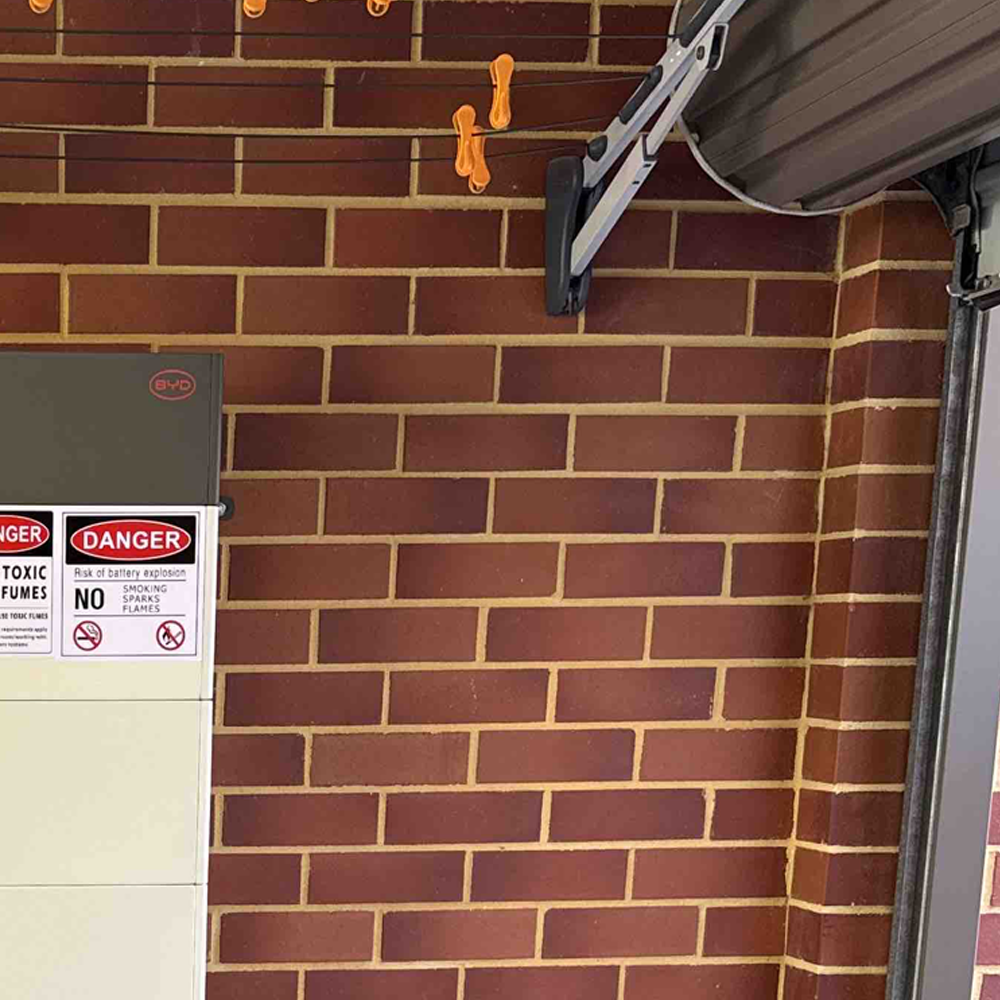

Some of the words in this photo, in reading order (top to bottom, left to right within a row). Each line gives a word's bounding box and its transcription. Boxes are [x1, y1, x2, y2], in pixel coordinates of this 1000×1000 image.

[156, 380, 190, 390] BYD
[83, 530, 181, 550] DANGER
[2, 565, 47, 580] TOXIC
[74, 567, 94, 578] Risk
[97, 567, 105, 578] of
[108, 567, 141, 580] battery
[144, 567, 187, 579] explosion
[1, 585, 47, 600] FUMES
[123, 584, 168, 594] SMOKING
[74, 587, 105, 611] NO
[122, 594, 161, 604] SPARKS
[122, 604, 161, 613] FLAMES
[10, 612, 27, 620] TOXIC
[29, 612, 48, 620] FUMES
